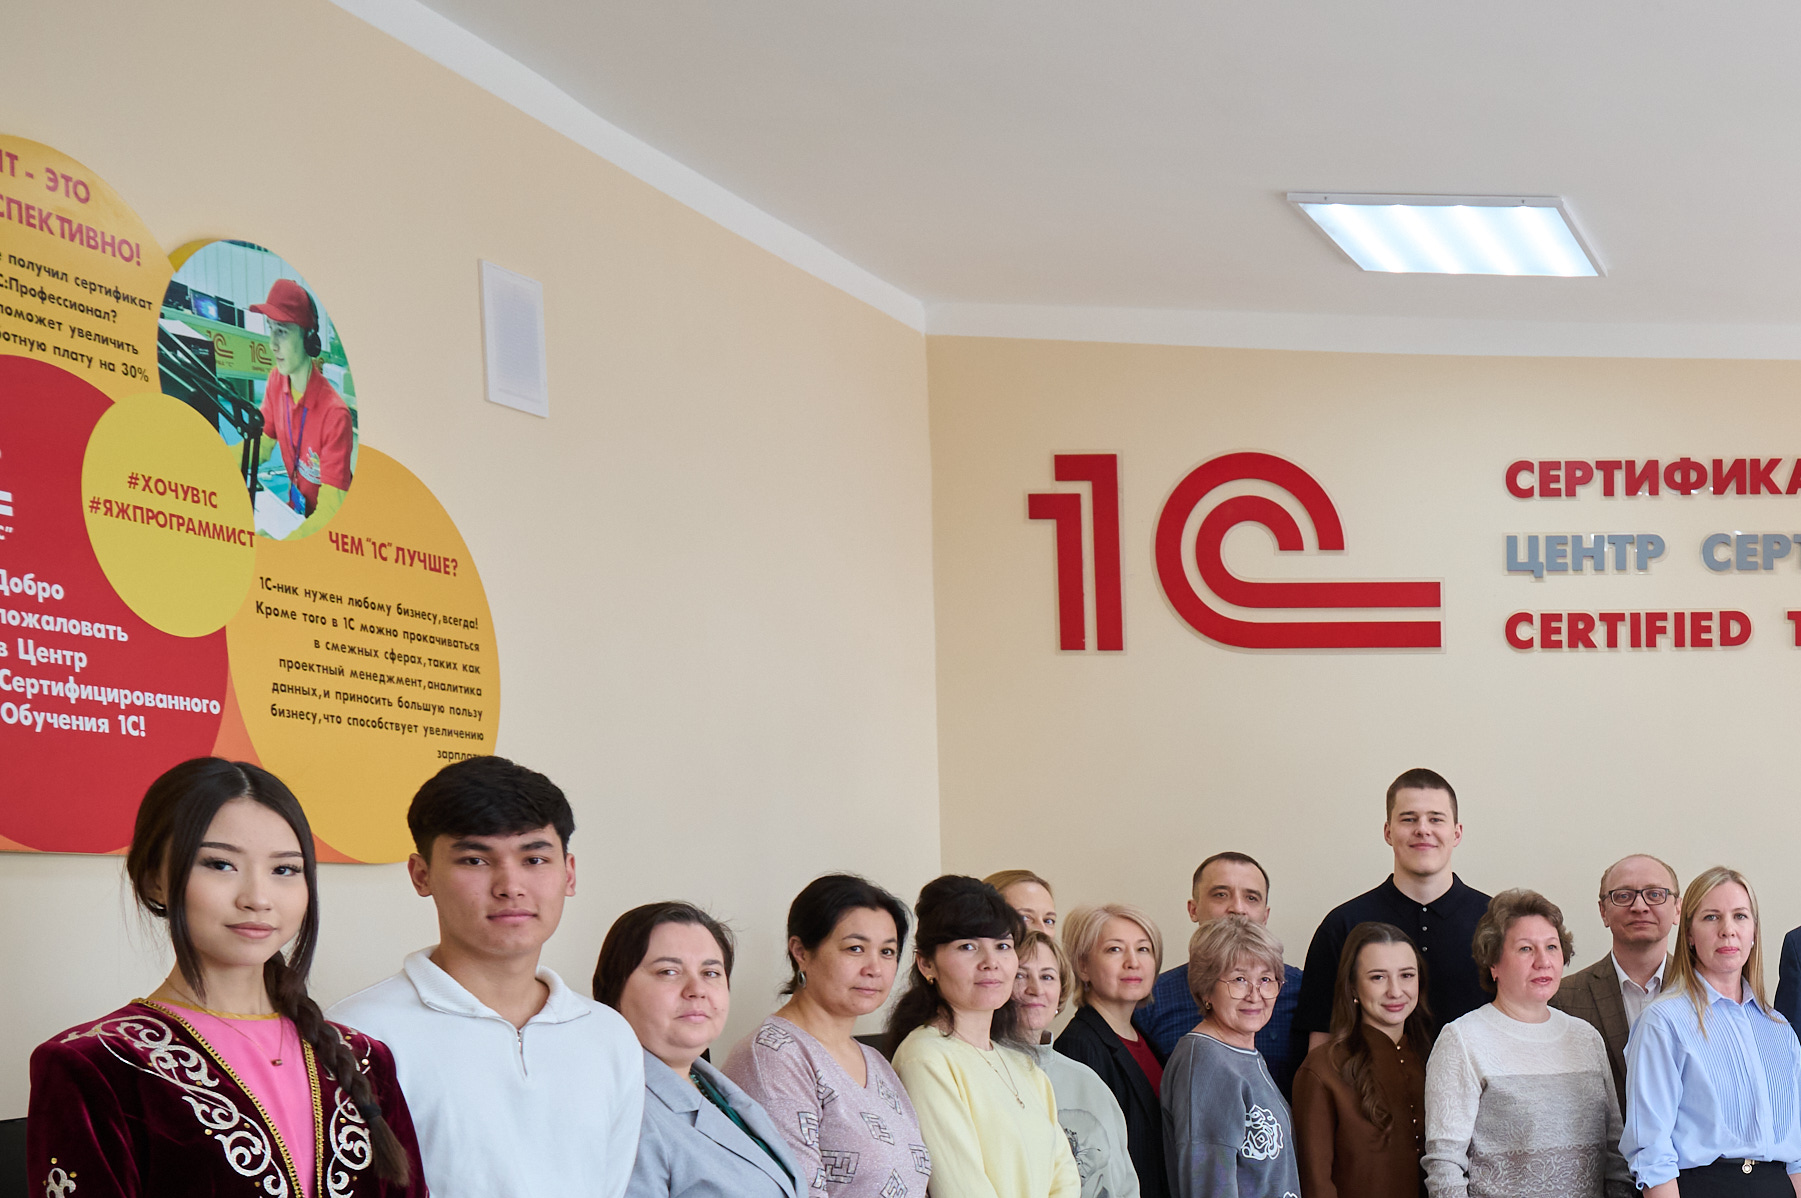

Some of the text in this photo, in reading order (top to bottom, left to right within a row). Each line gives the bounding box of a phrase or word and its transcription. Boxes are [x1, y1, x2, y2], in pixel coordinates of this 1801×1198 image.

[45, 167, 91, 204] ЭТО
[8, 254, 153, 311] получил сертификат
[0, 331, 149, 383] отную плату на 30%
[69, 325, 139, 356] увеличить
[127, 472, 218, 509] #ХОЧУВ1С
[89, 496, 255, 548] #ЯЖПРОГРАММИСТ
[328, 530, 364, 557] ЧЕМ
[394, 546, 458, 577] ЛУЧШЕ?
[1028, 451, 1441, 651] 1С
[1505, 534, 1666, 579] ЦЕНТР
[0, 568, 64, 602] Добро
[259, 576, 299, 596] 1С-ник
[304, 587, 343, 605] нужен
[347, 595, 392, 617] любому
[0, 608, 129, 642] пожаловать
[256, 600, 480, 652] Кроме того в 1С можно прокачиваться
[1505, 611, 1752, 650] CERTIFIED
[18, 637, 88, 672] Центр
[279, 657, 345, 677] проектный
[314, 637, 321, 649] в
[325, 640, 380, 659] смежных
[462, 662, 481, 675] как
[0, 668, 221, 715] Сертифицированного
[335, 690, 393, 708] приносить
[397, 696, 445, 716] большую
[449, 704, 483, 722] пользу
[1, 702, 147, 737] Обучения 1С!
[347, 714, 419, 735] способствует
[423, 722, 485, 742] увеличению
